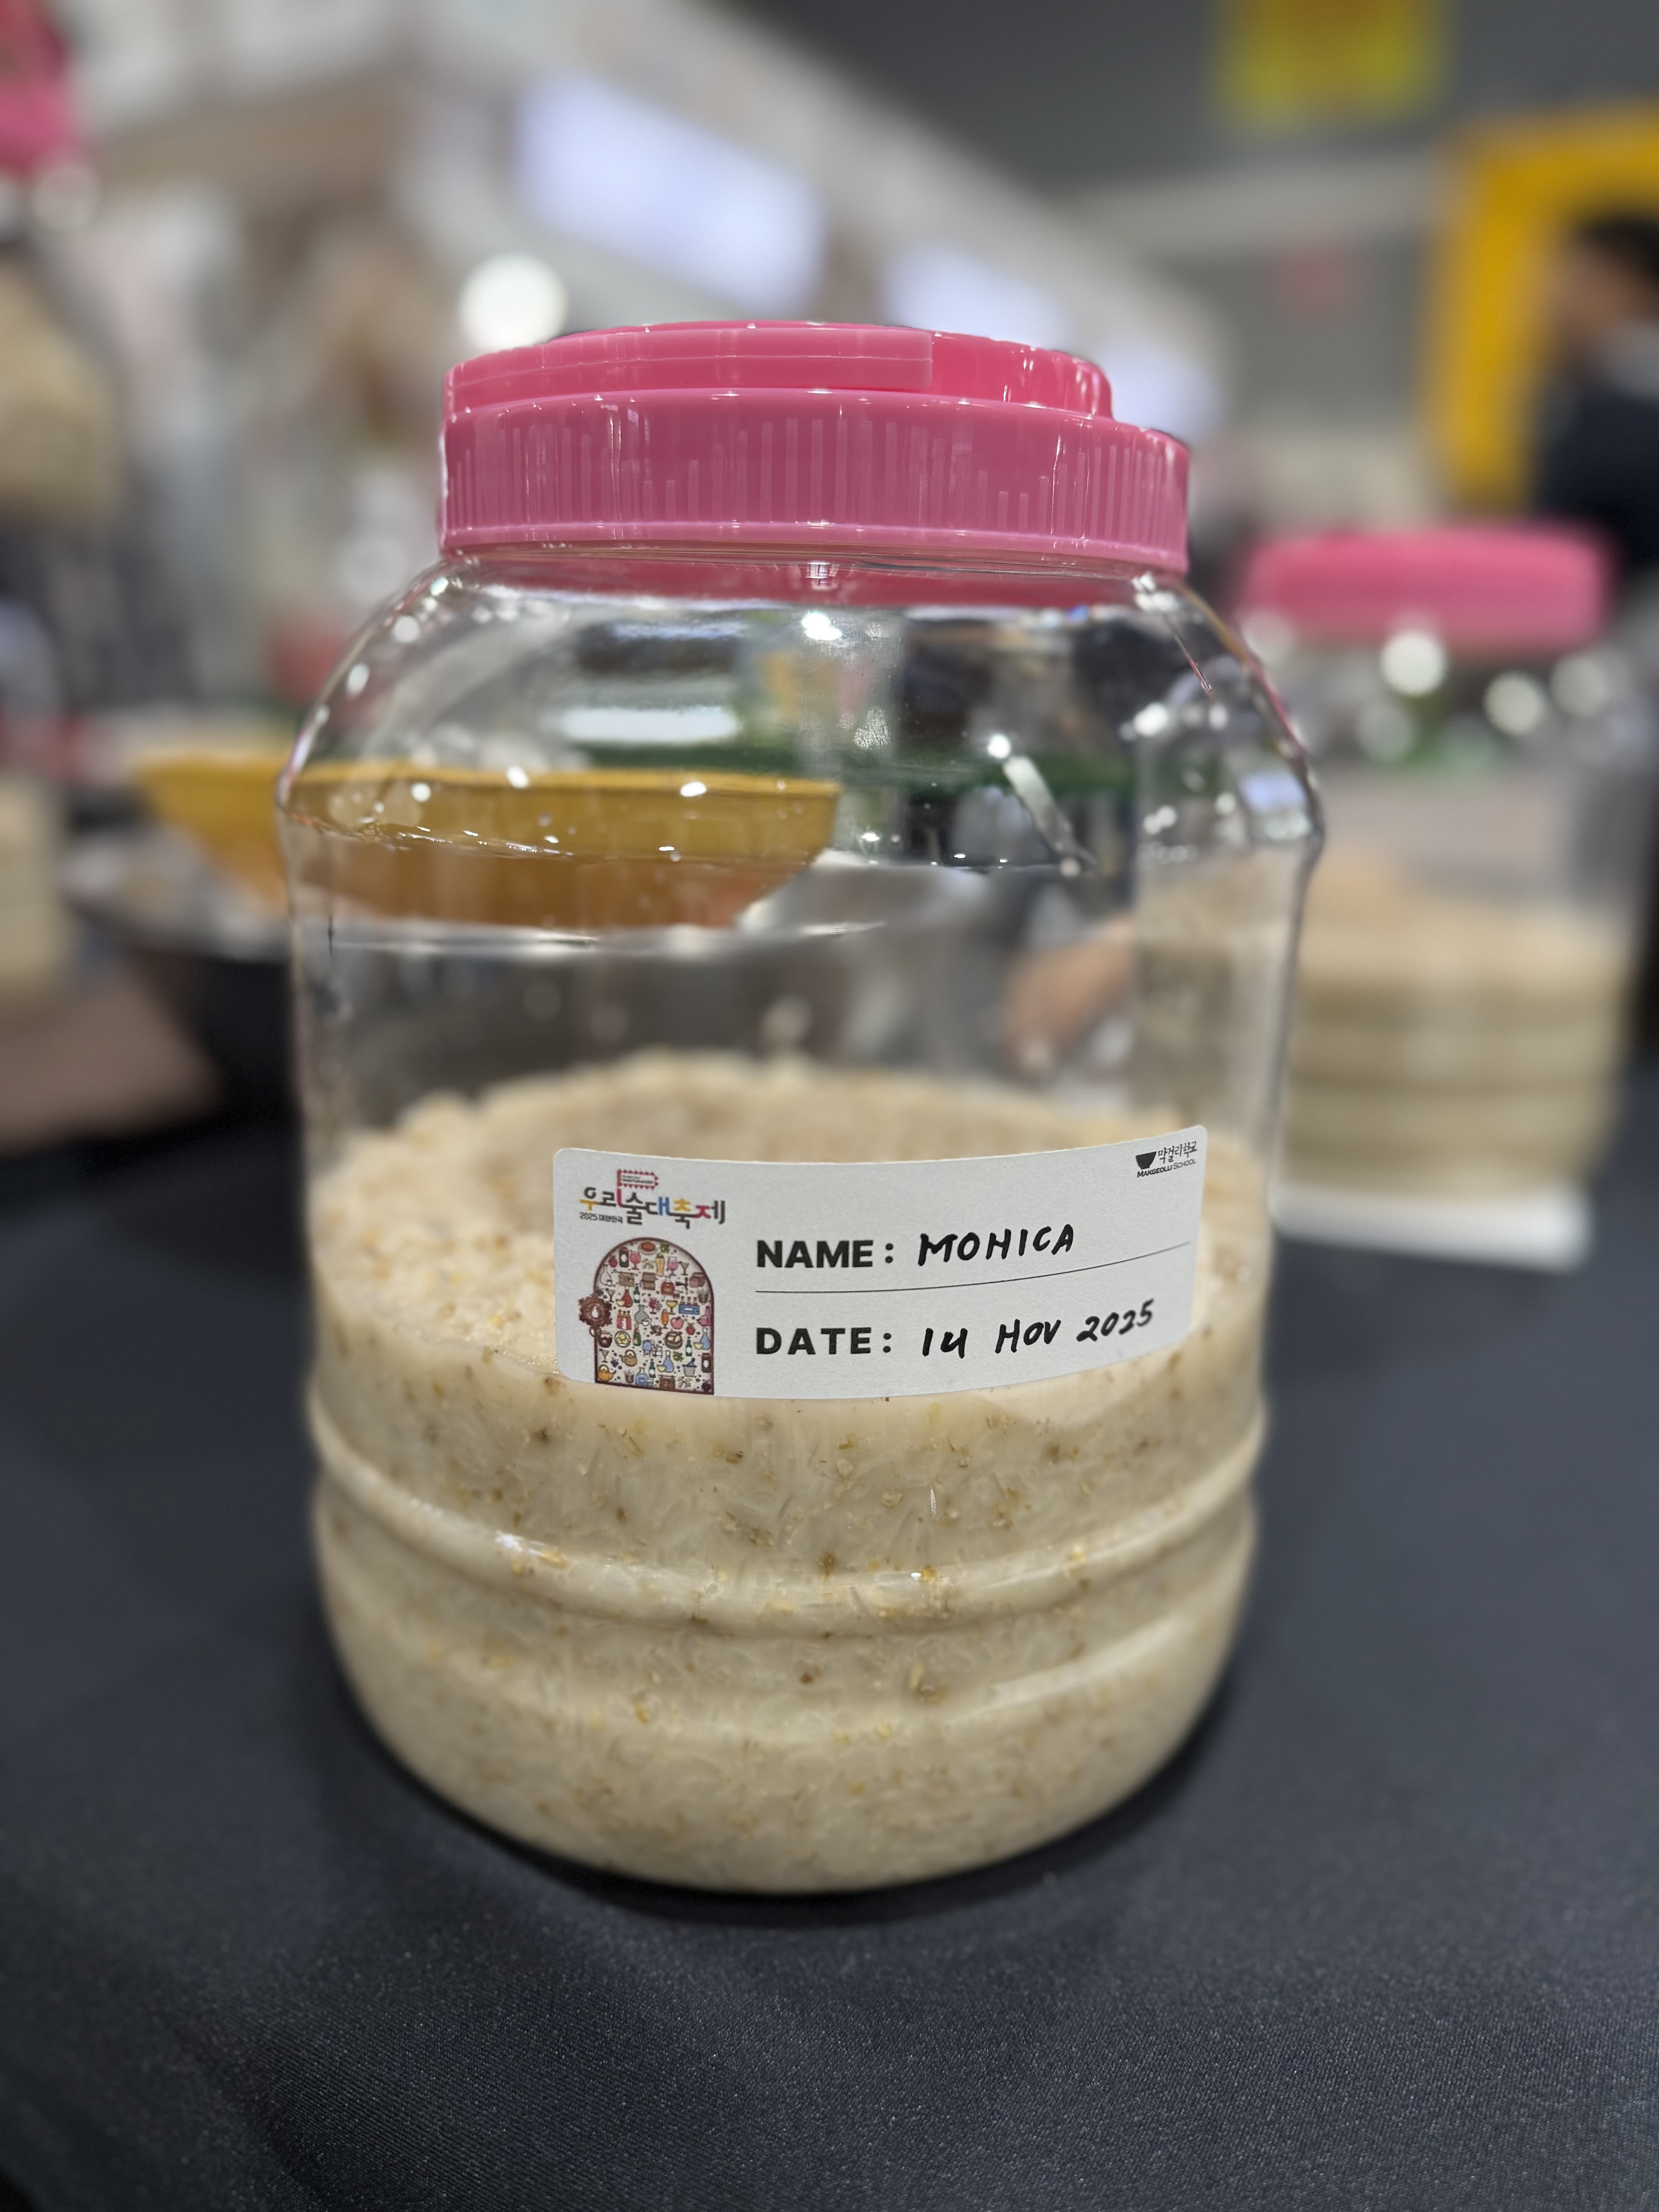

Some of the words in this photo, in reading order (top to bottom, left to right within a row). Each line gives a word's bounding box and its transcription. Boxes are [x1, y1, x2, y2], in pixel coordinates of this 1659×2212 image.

[1158, 1141, 1197, 1164] 막걸리학교
[1137, 1165, 1172, 1178] MAKGEOLLI
[1173, 1159, 1196, 1169] SCHOOL
[580, 1212, 598, 1221] 2025
